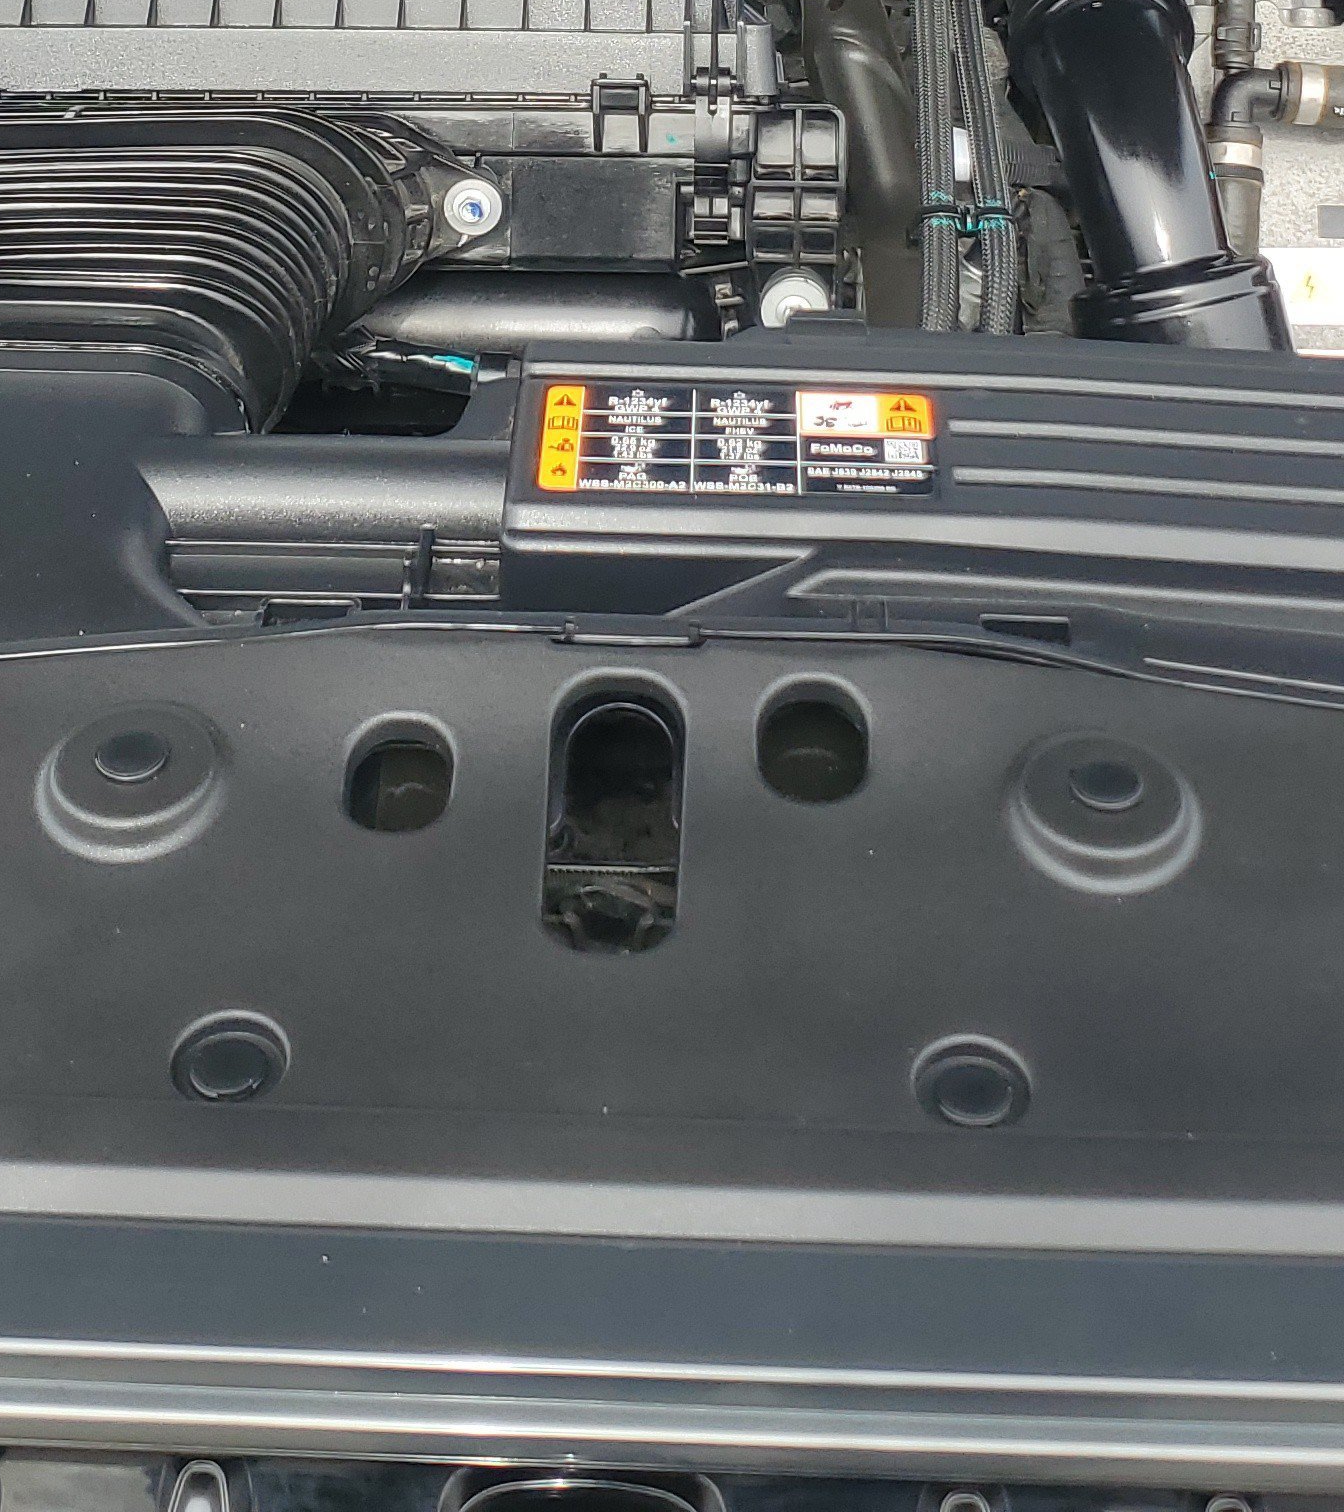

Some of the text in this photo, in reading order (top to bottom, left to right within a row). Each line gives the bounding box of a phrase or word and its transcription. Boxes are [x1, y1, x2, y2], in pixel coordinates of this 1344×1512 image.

[607, 415, 663, 424] NAUTILUS
[712, 416, 768, 426] NAUTILUS
[624, 425, 645, 433] ICE
[640, 437, 656, 447] kg
[746, 439, 762, 449] kg
[809, 443, 874, 455] FoMoCo
[618, 472, 647, 480] PAG
